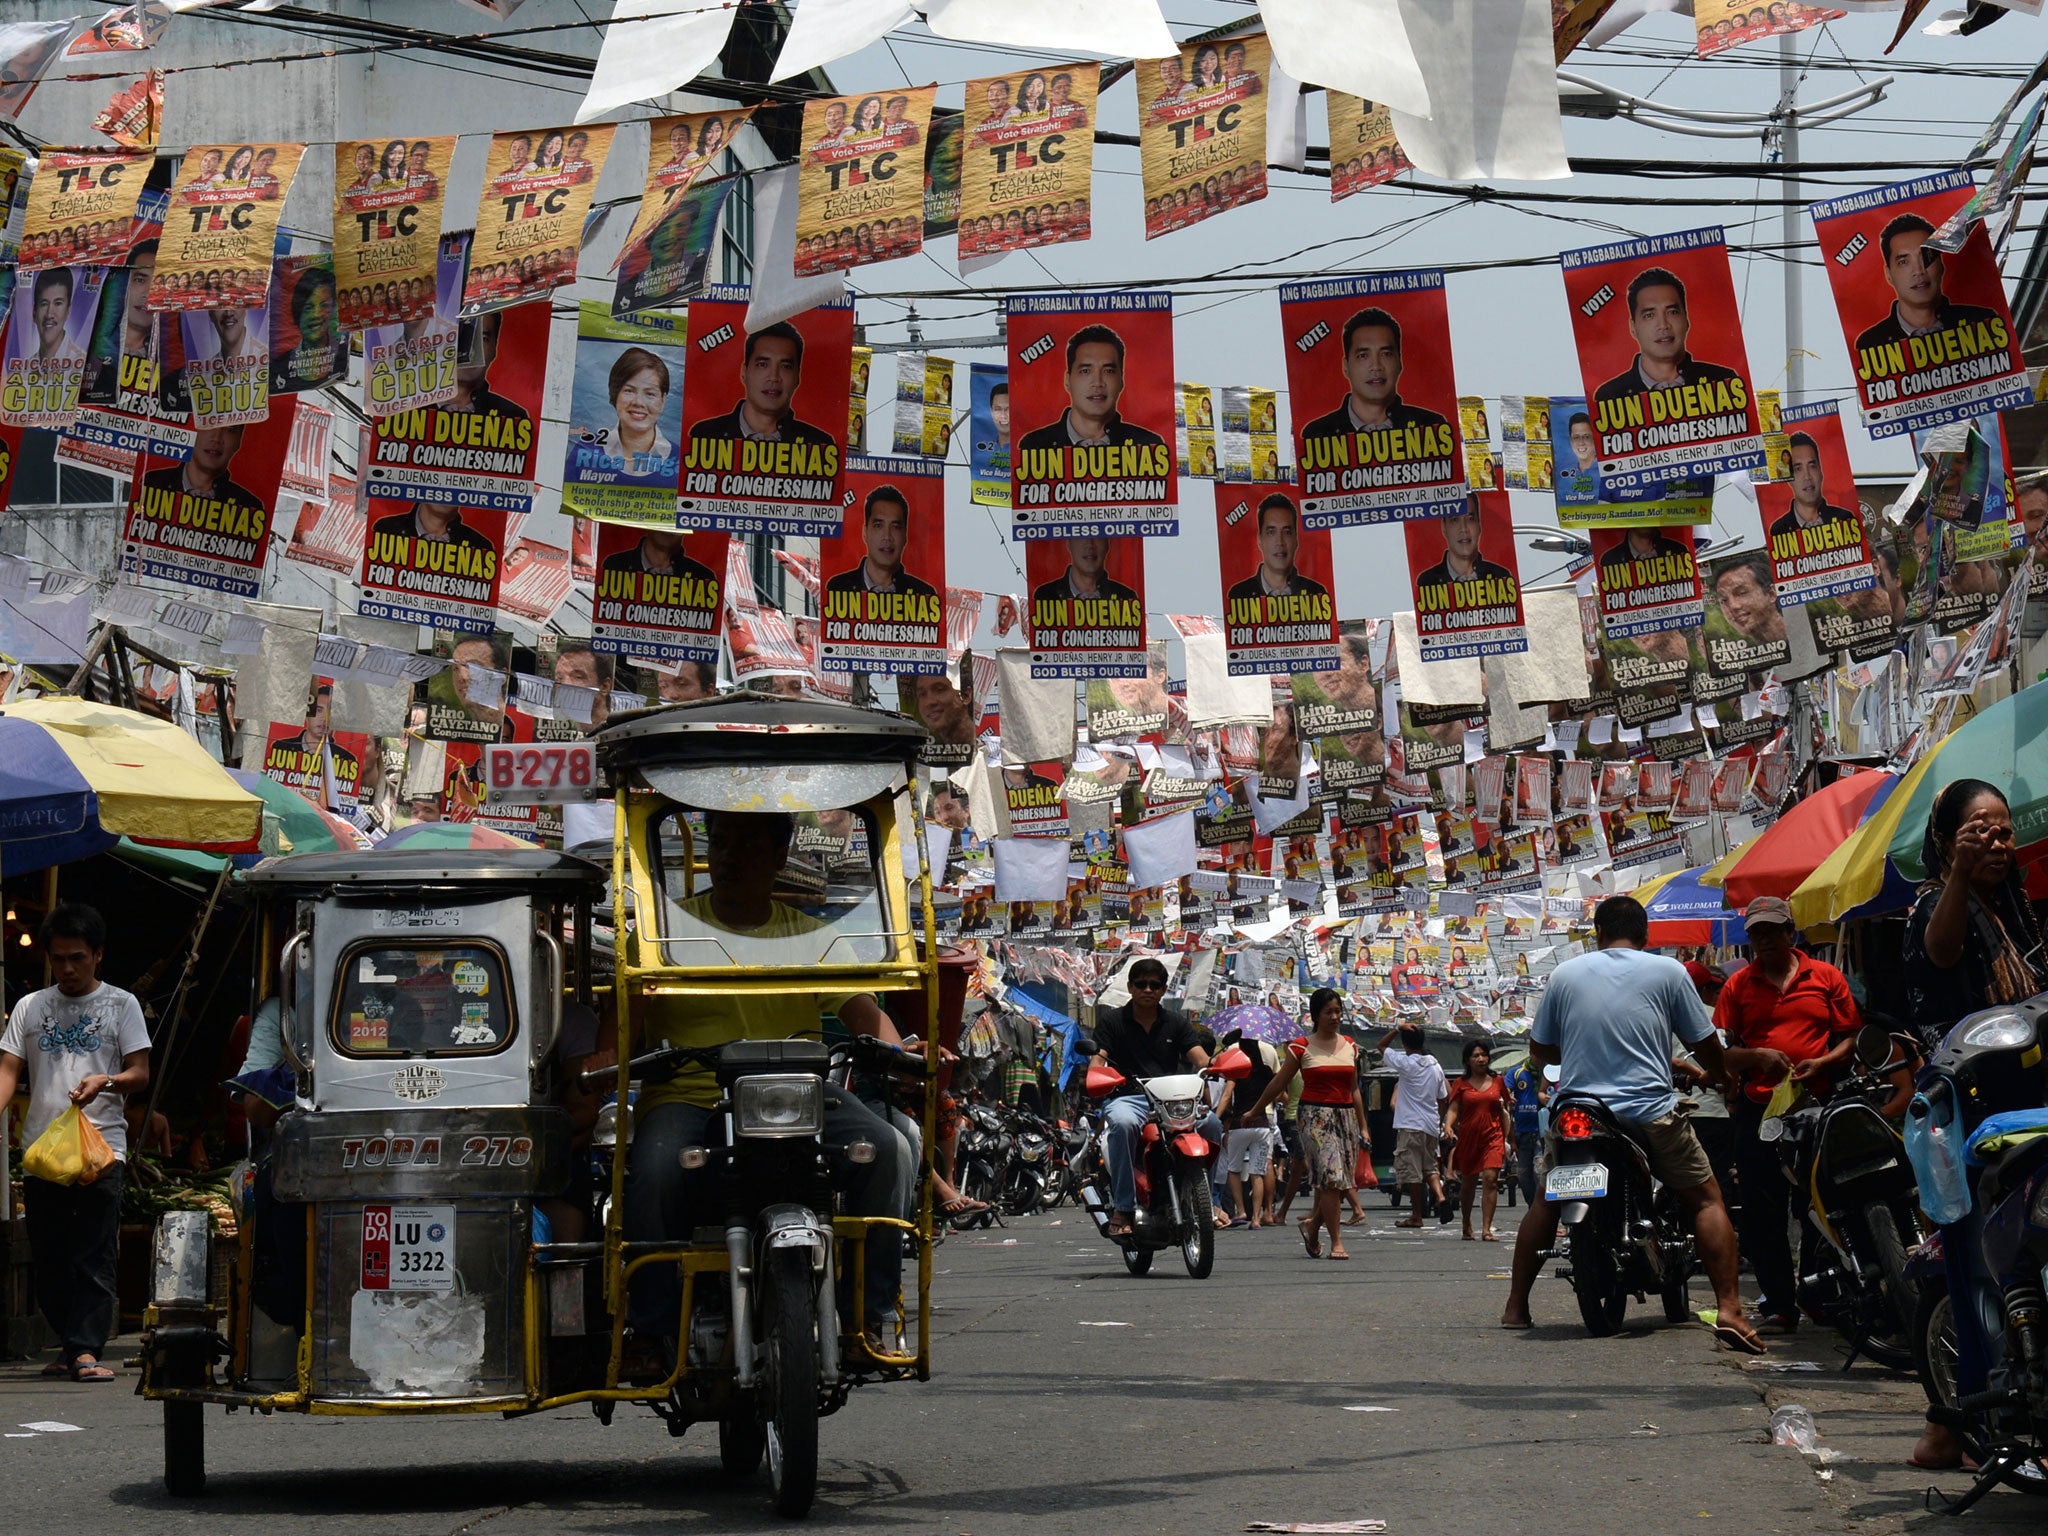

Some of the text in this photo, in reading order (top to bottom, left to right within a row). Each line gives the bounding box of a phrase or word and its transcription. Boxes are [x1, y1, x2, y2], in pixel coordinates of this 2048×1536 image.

[1174, 91, 1237, 117] Vote Straight!
[997, 122, 1061, 140] Vote Straight!
[1168, 104, 1241, 149] TLC
[990, 134, 1065, 174] TLC
[1169, 136, 1240, 168] TEAM LANI
[1169, 146, 1239, 179] CAYETANO
[57, 163, 126, 193] TLC
[512, 176, 570, 191] Vote Straight!
[825, 152, 898, 191] TLC
[989, 170, 1063, 192] TEAM LANI
[824, 186, 895, 210] TEAM LANI
[989, 180, 1062, 203] CAYETANO
[189, 203, 256, 232] TLC
[502, 188, 570, 222] TLC
[823, 197, 894, 220] CAYETANO
[356, 205, 419, 242] TLC
[498, 220, 562, 241] TEAM LANI
[183, 236, 248, 250] TEAM LANI
[496, 230, 560, 251] CAYETANO
[1835, 232, 1869, 266] VOTE!
[181, 247, 247, 261] CAYETANO
[1009, 294, 1168, 312] ANG PAGBABALIK KO AY PARA SA INYO
[1582, 284, 1615, 318] VOTE!
[373, 330, 457, 360] RICARDO
[698, 324, 734, 352] VOTE!
[1296, 320, 1330, 352] VOTE!
[1857, 316, 2009, 381] JUN DUEÑAS
[1020, 334, 1055, 364] VOTE!
[10, 357, 84, 370] RICARDO
[371, 360, 455, 403] CRUZ
[1867, 352, 2011, 404] FOR CONGRESSMAN
[3, 384, 79, 412] CRUZ
[373, 388, 454, 413] VICE MAYOR
[1596, 376, 1747, 433] JUN DUEÑAS
[2, 412, 74, 423] VICE MAYOR
[1872, 392, 2026, 438] GOD BLESS OUR CITY
[377, 409, 532, 450] JUN DUEÑAS
[596, 429, 609, 445] 2
[1602, 413, 1747, 455] FOR CONGRESSMAN
[685, 436, 838, 478] JUN DUEÑAS
[1300, 421, 1454, 470] JUN DUEÑAS
[576, 448, 678, 473] Rica Ting
[1016, 440, 1170, 482] JUN DUEÑAS
[1606, 454, 1760, 490] GOD BLESS OUR CITY
[580, 470, 618, 484] Mayor
[686, 473, 834, 500] FOR CONGRESSMAN
[1306, 460, 1452, 494] FOR CONGRESSMAN
[572, 486, 604, 497] Huwag
[572, 496, 630, 508] Scholarship
[1019, 480, 1166, 504] FOR CONGRESSMAN
[1620, 489, 1643, 497] Mayor
[134, 486, 266, 540] JUN DUEÑAS
[1031, 506, 1173, 522] 2. DUEÑAS, HENRY JR. (NPC)
[1306, 502, 1462, 528] GOD BLESS OUR CITY
[1562, 508, 1663, 521] Serbisyong Ramdam Mo!
[679, 516, 836, 536] GOD BLESS OUR CITY
[1016, 523, 1173, 539] GOD BLESS OUR CITY
[1771, 517, 1861, 561] JUN DUEÑAS
[368, 532, 496, 580] JUN DUEÑAS
[1601, 552, 1694, 591] JUN DUEÑAS
[598, 569, 719, 609] JUN DUEÑAS
[1418, 574, 1517, 612] JUN DUEÑAS
[825, 588, 940, 622] JUN DUEÑAS
[1032, 595, 1141, 627] JUN DUEÑAS
[1228, 590, 1332, 626] JUN DUEÑAS
[316, 643, 356, 668] DIZON
[1710, 638, 1746, 652] Lino
[1712, 640, 1786, 662] CAYETANO
[1719, 652, 1785, 670] Congressman
[431, 705, 464, 719] Lino
[1092, 710, 1128, 722] Lino
[1092, 713, 1165, 732] CAYETANO
[1300, 704, 1336, 716] Lino
[1300, 709, 1374, 728] CAYETANO
[430, 719, 499, 733] CAYETANO
[433, 728, 494, 741] Congressman
[1098, 722, 1161, 737] Congressman
[1306, 721, 1371, 735] Congressman
[491, 748, 592, 787] B-278
[1359, 968, 1390, 976] SUPAN
[1453, 968, 1485, 976] SUPAN
[353, 1027, 387, 1037] 2012
[343, 1137, 533, 1168] TODA 278
[1552, 1175, 1600, 1190] REGISTRATION
[366, 1212, 388, 1226] TO
[366, 1227, 389, 1240] DA
[395, 1224, 420, 1245] LU
[400, 1252, 444, 1271] 3322
